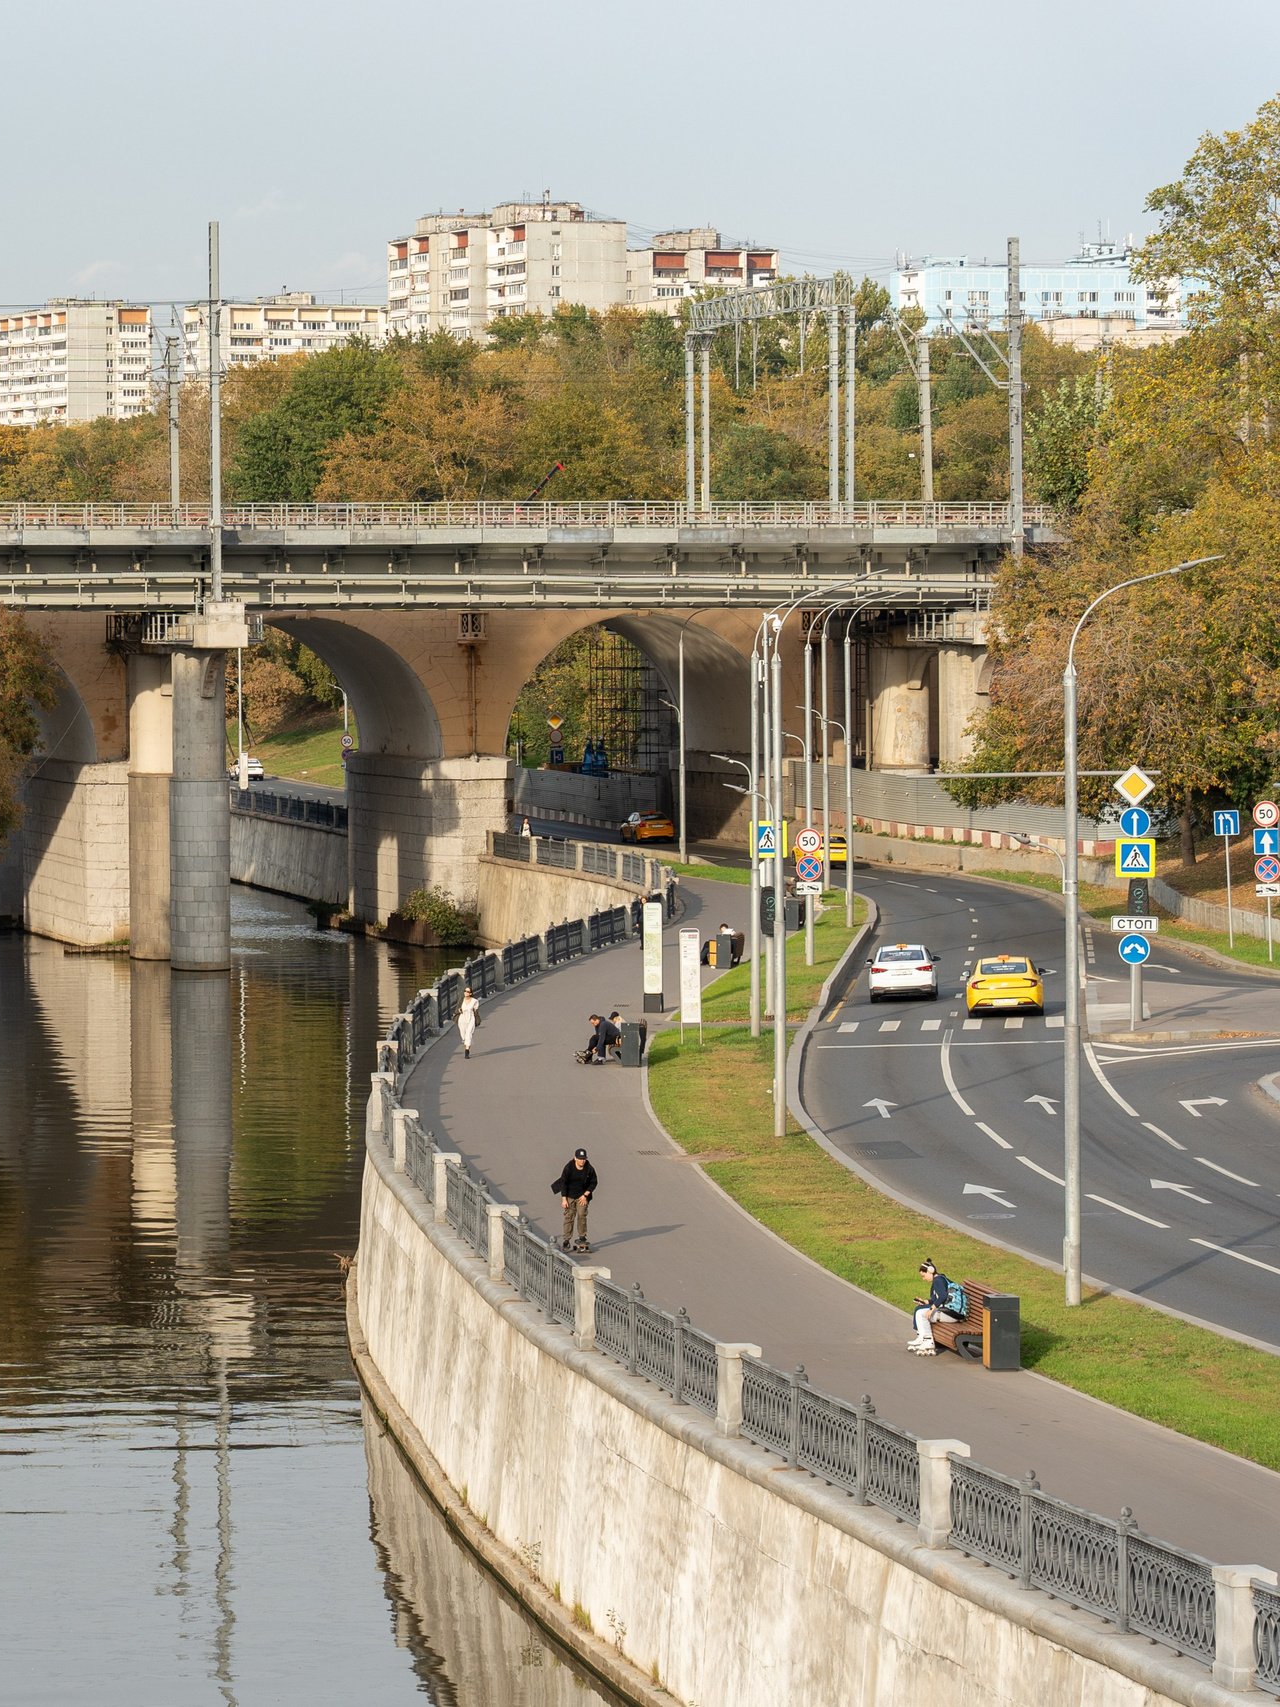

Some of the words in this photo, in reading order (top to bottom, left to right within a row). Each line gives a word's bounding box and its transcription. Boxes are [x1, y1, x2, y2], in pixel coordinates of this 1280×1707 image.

[1259, 809, 1273, 819] 50
[802, 836, 816, 846] 50
[1117, 919, 1152, 930] СТОП
